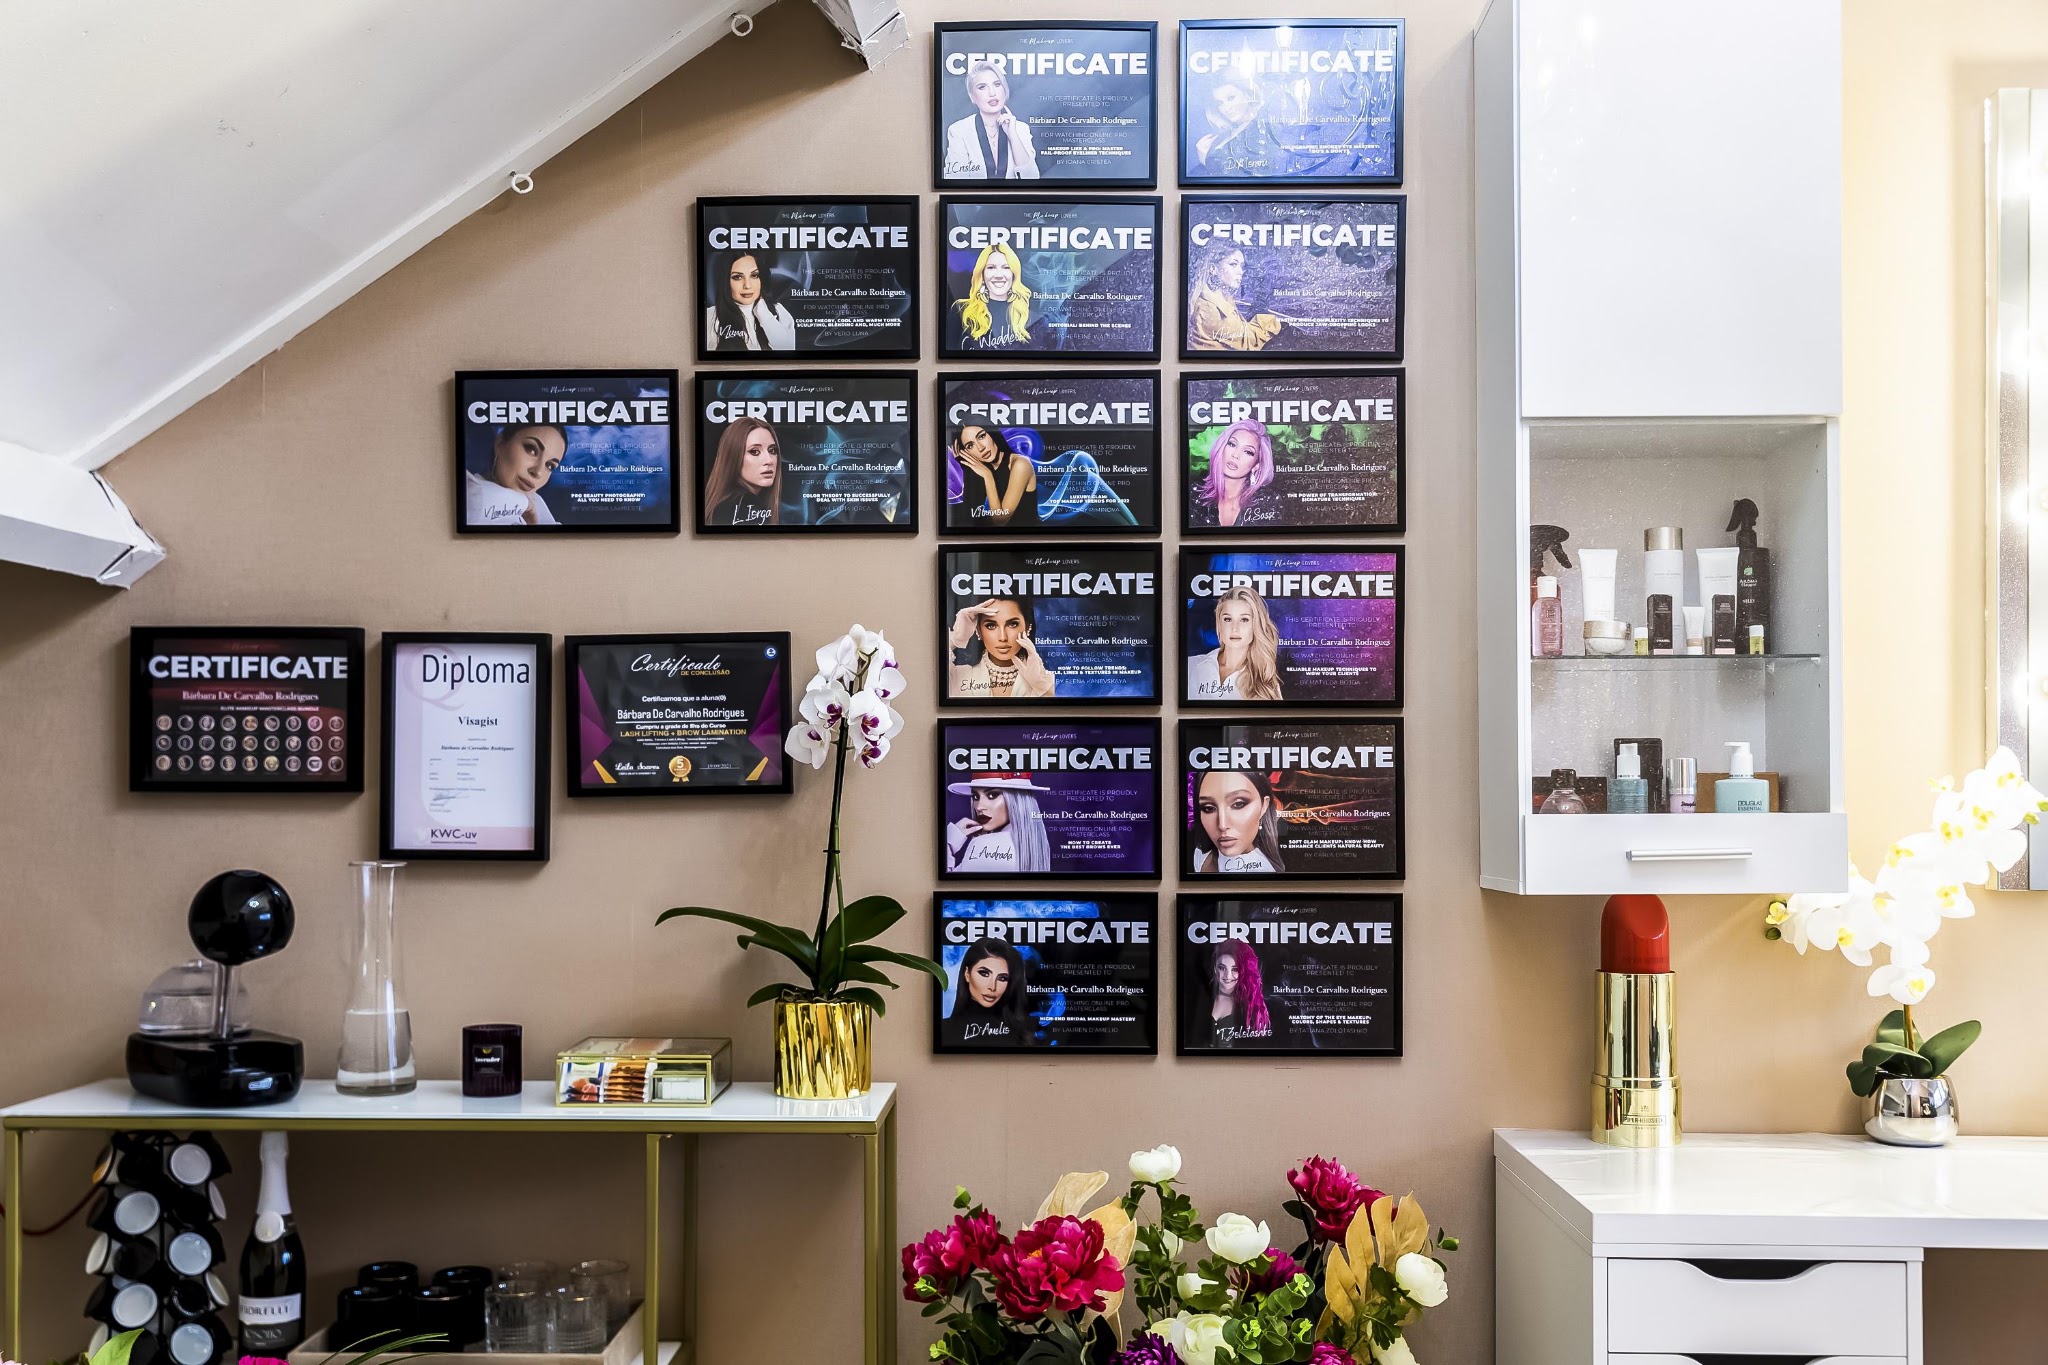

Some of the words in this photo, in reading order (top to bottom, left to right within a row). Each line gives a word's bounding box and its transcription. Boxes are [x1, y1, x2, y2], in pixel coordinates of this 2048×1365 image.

[946, 53, 1147, 75] CERTIFICATE
[1103, 117, 1137, 125] Rodrigues
[709, 227, 908, 249] CERTIFICATE
[949, 226, 1152, 250] CERTIFICATE
[1191, 224, 1395, 246] CERTIFICATE
[870, 289, 905, 297] Rodrigues
[468, 401, 668, 423] CERTIFICATE
[706, 401, 907, 423] CERTIFICATE
[949, 403, 1149, 425] CERTIFICATE
[1190, 399, 1393, 424] CERTIFICATE
[631, 465, 663, 473] Rodrigues
[1113, 465, 1147, 474] Rodrigues
[1351, 464, 1386, 472] Rodrigues
[951, 573, 1154, 595] CERTIFICATE
[1191, 575, 1394, 596] CERTIFICATE
[1112, 637, 1147, 646] Rodrigues
[1355, 639, 1390, 647] Rodrigues
[148, 655, 348, 679] CERTIFICATE
[423, 654, 530, 690] Diploma
[631, 654, 722, 677] Certificado
[458, 716, 498, 727] Visagist
[617, 709, 651, 719] Bárbara
[653, 709, 663, 718] De
[665, 708, 701, 718] Carvalho
[703, 708, 744, 719] Rodrigues
[677, 759, 683, 768] 5
[948, 748, 1151, 770] CERTIFICATE
[1189, 747, 1393, 769] CERTIFICATE
[1111, 811, 1147, 820] Rodrigues
[1354, 810, 1390, 818] Rodrigues
[431, 829, 477, 838] KWC-uv
[945, 921, 1149, 943] CERTIFICATE
[1188, 922, 1392, 944] CERTIFICATE
[1106, 985, 1144, 995] Rodrigues
[1351, 986, 1387, 995] Rodrigues
